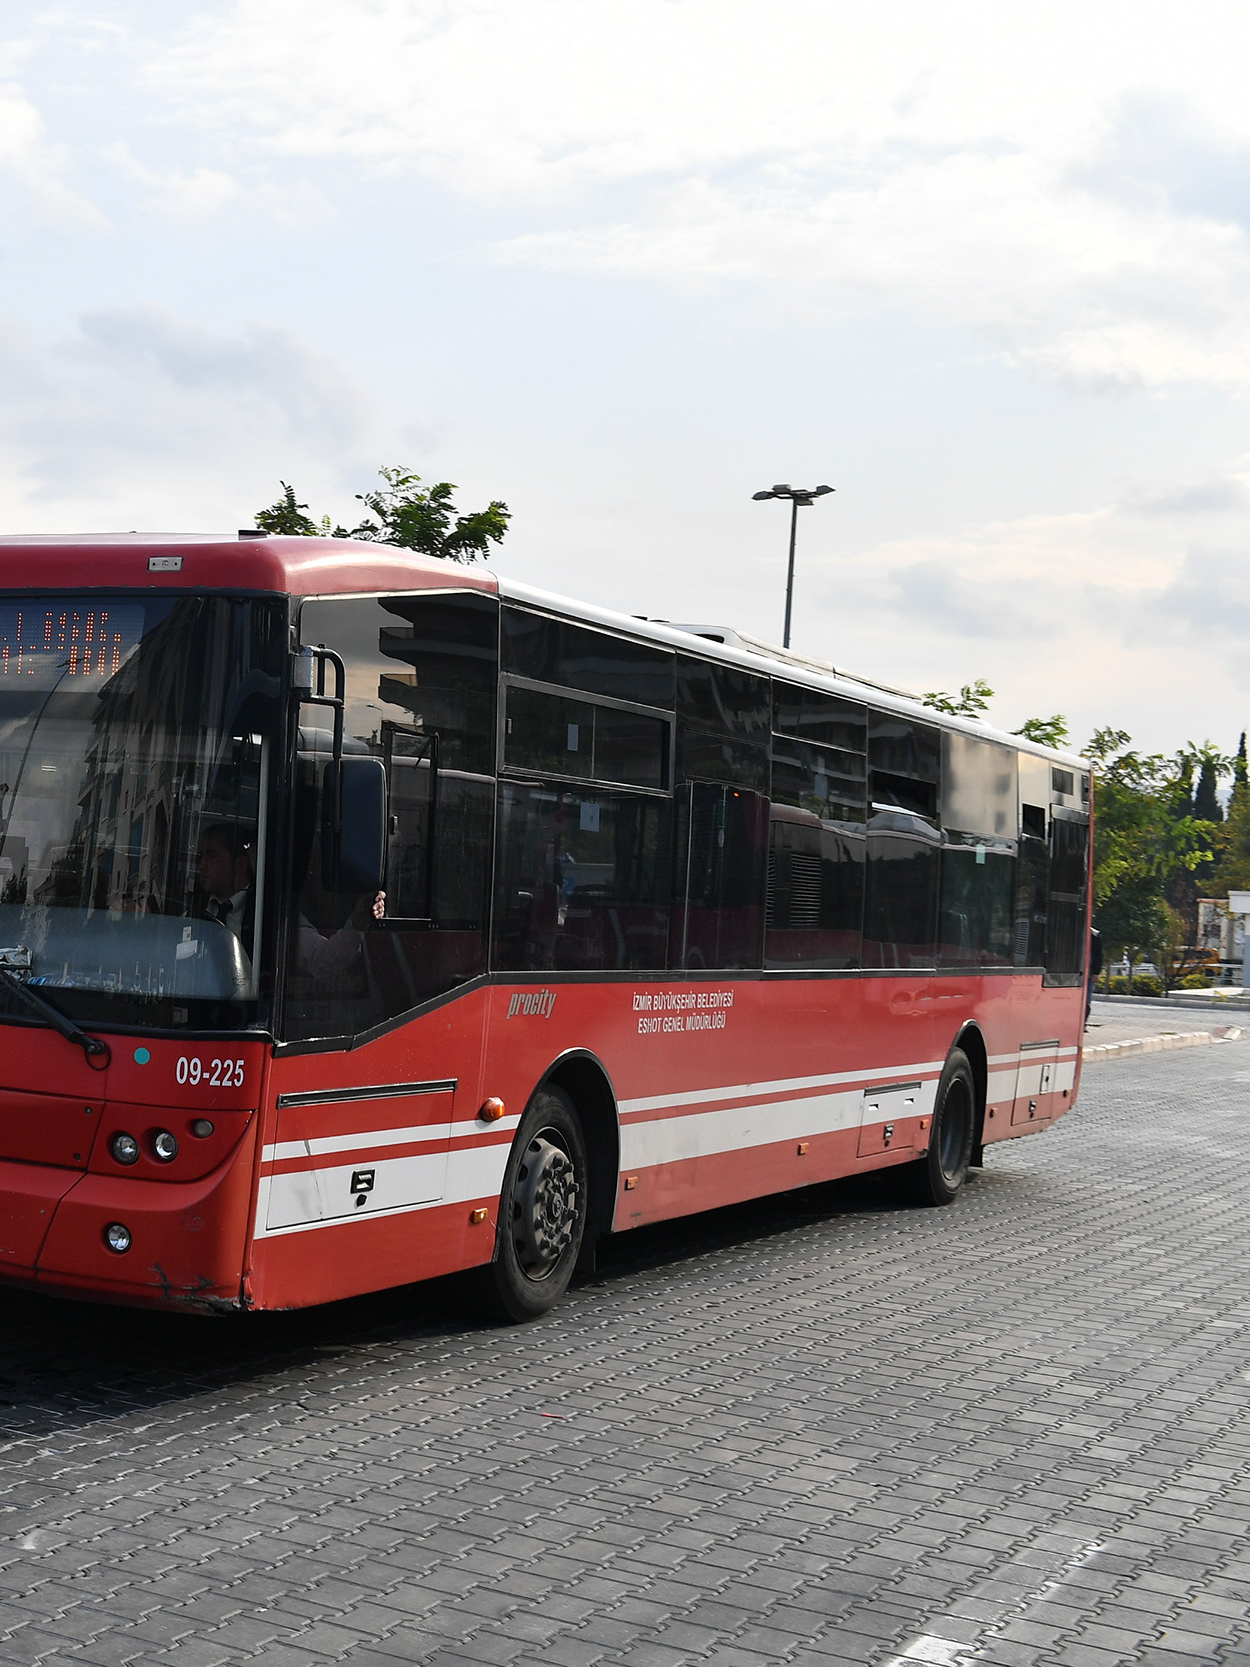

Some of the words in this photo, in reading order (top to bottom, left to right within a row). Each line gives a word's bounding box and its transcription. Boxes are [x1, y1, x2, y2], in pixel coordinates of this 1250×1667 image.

[506, 989, 556, 1020] procity
[632, 991, 652, 1011] İZMİR
[653, 990, 696, 1014] BÜYÜKŞEHİR
[697, 989, 734, 1009] BELEDİYESİ
[638, 1016, 662, 1034] ESHOT
[662, 1015, 685, 1033] GENEL
[686, 1010, 726, 1032] MÜDÜRLÜĞÜ
[176, 1056, 245, 1087] 09-225
